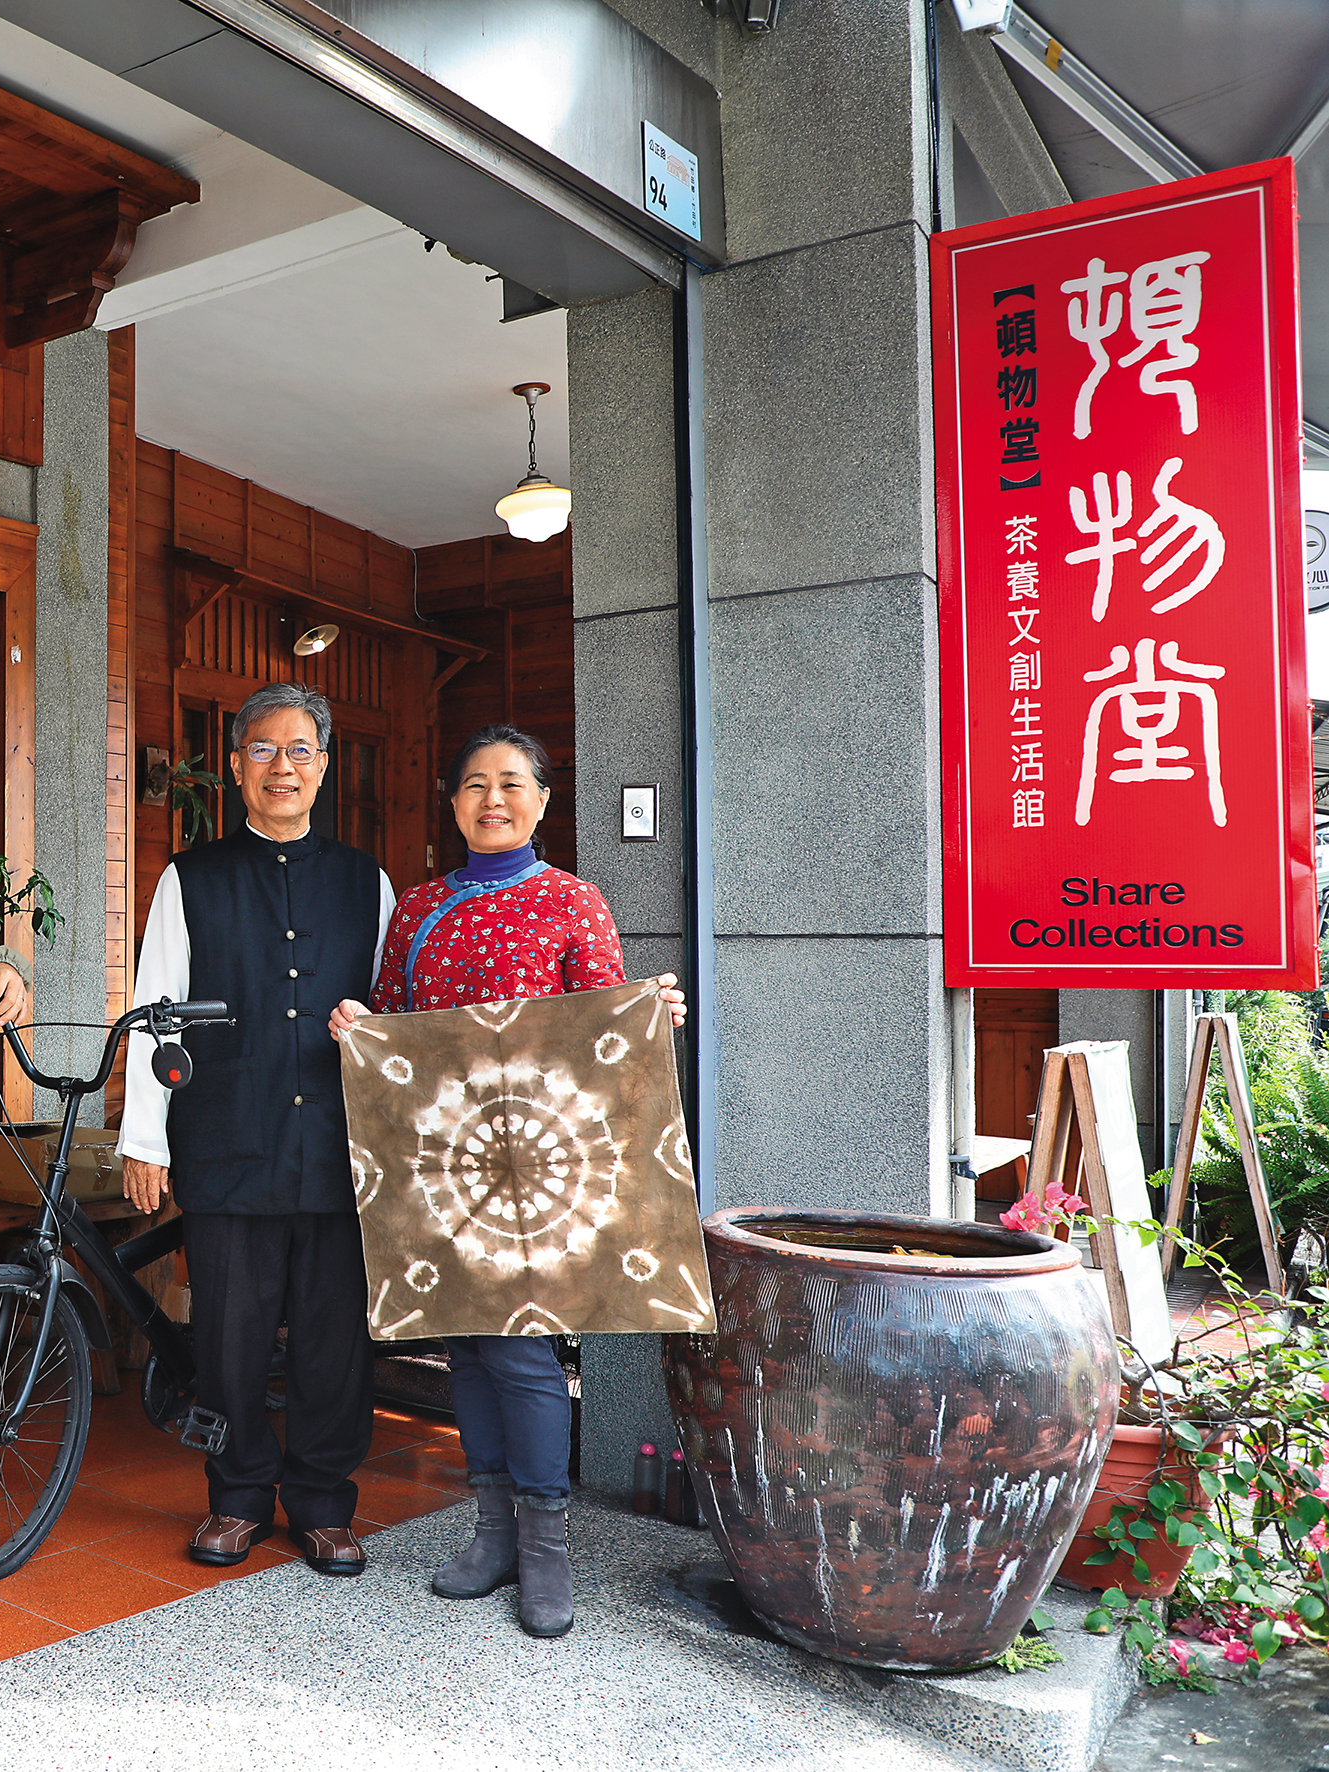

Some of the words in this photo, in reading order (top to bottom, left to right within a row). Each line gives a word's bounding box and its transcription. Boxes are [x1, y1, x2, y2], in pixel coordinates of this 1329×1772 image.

[649, 175, 668, 211] 94
[1060, 250, 1228, 828] 頓物堂
[1005, 515, 1045, 829] 茶養文創生活館
[1060, 876, 1186, 908] Share
[1009, 915, 1245, 949] Collections
